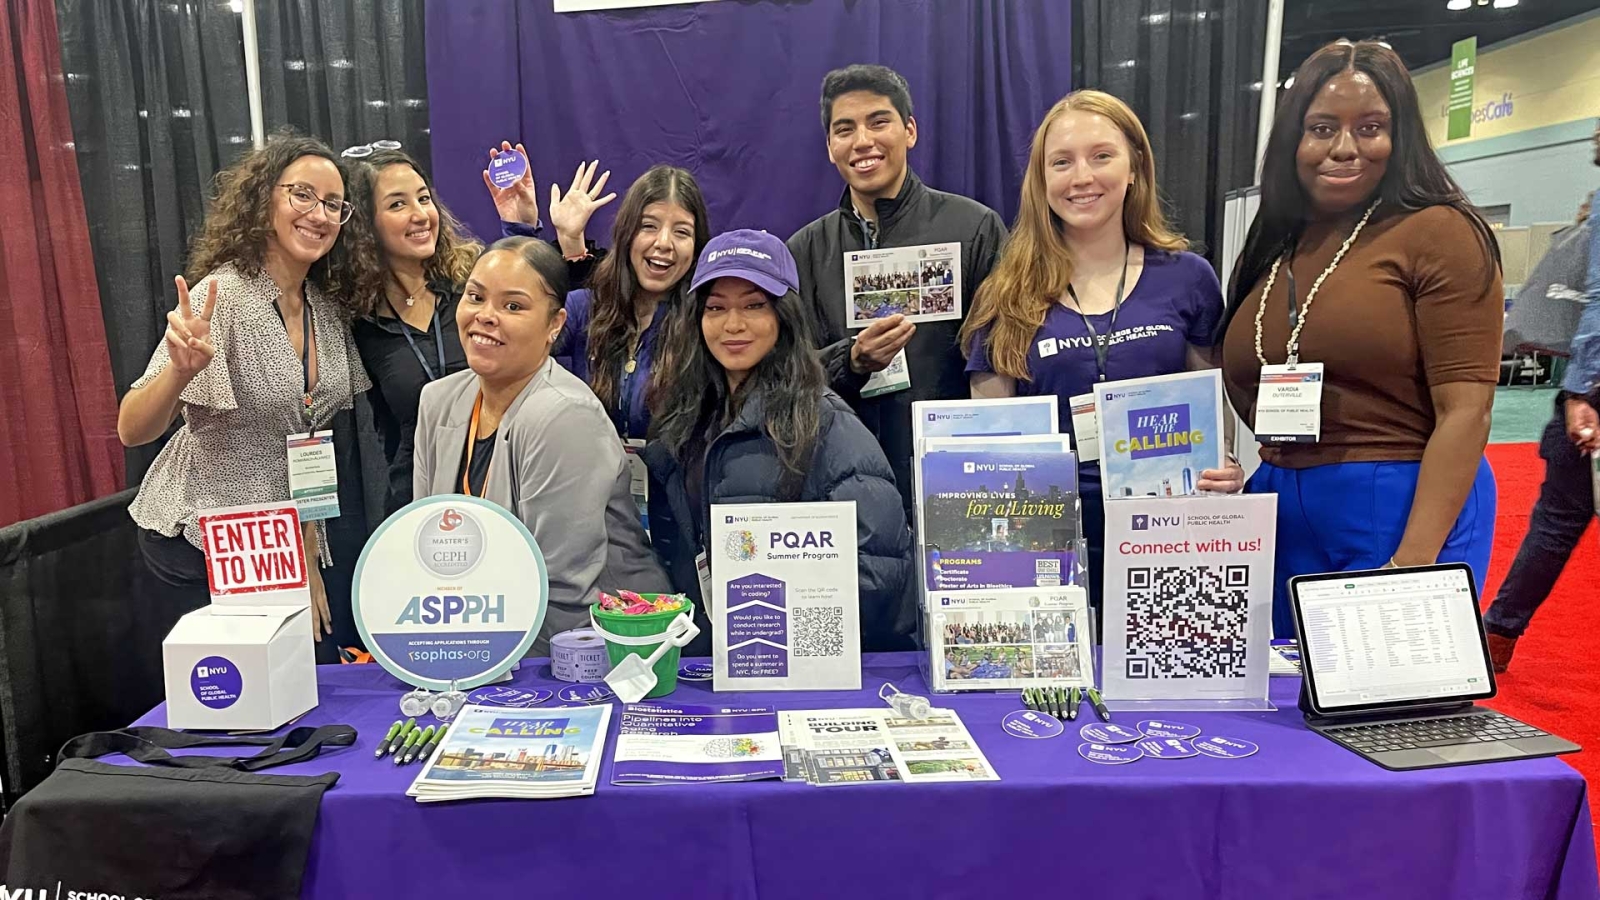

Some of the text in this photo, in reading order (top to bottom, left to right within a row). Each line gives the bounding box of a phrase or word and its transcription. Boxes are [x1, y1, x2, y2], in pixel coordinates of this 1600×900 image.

[503, 156, 517, 165] NYU
[717, 248, 734, 257] NYU
[1126, 330, 1158, 341] HEALTH
[1059, 337, 1093, 350] NYU
[1137, 412, 1179, 428] HEAR
[1152, 422, 1176, 434] THE
[1114, 430, 1204, 454] CALLING
[966, 499, 1065, 519] for a Living
[1152, 516, 1180, 527] NYU
[211, 518, 290, 553] ENTER
[770, 531, 834, 549] PQAR
[1119, 538, 1261, 554] Connect with us!
[433, 551, 467, 562] CEPH
[766, 552, 839, 560] Summer Program
[215, 551, 297, 585] TO WIN
[1037, 560, 1059, 568] BEST
[395, 594, 505, 625] ASPPH
[580, 654, 600, 662] TICKET
[209, 667, 227, 675] NYU
[627, 706, 683, 714] Biostatistics
[623, 714, 677, 722] Pipelines
[469, 727, 581, 736] CALLING
[809, 725, 880, 733] TOUR
[1225, 741, 1246, 749] NYU
